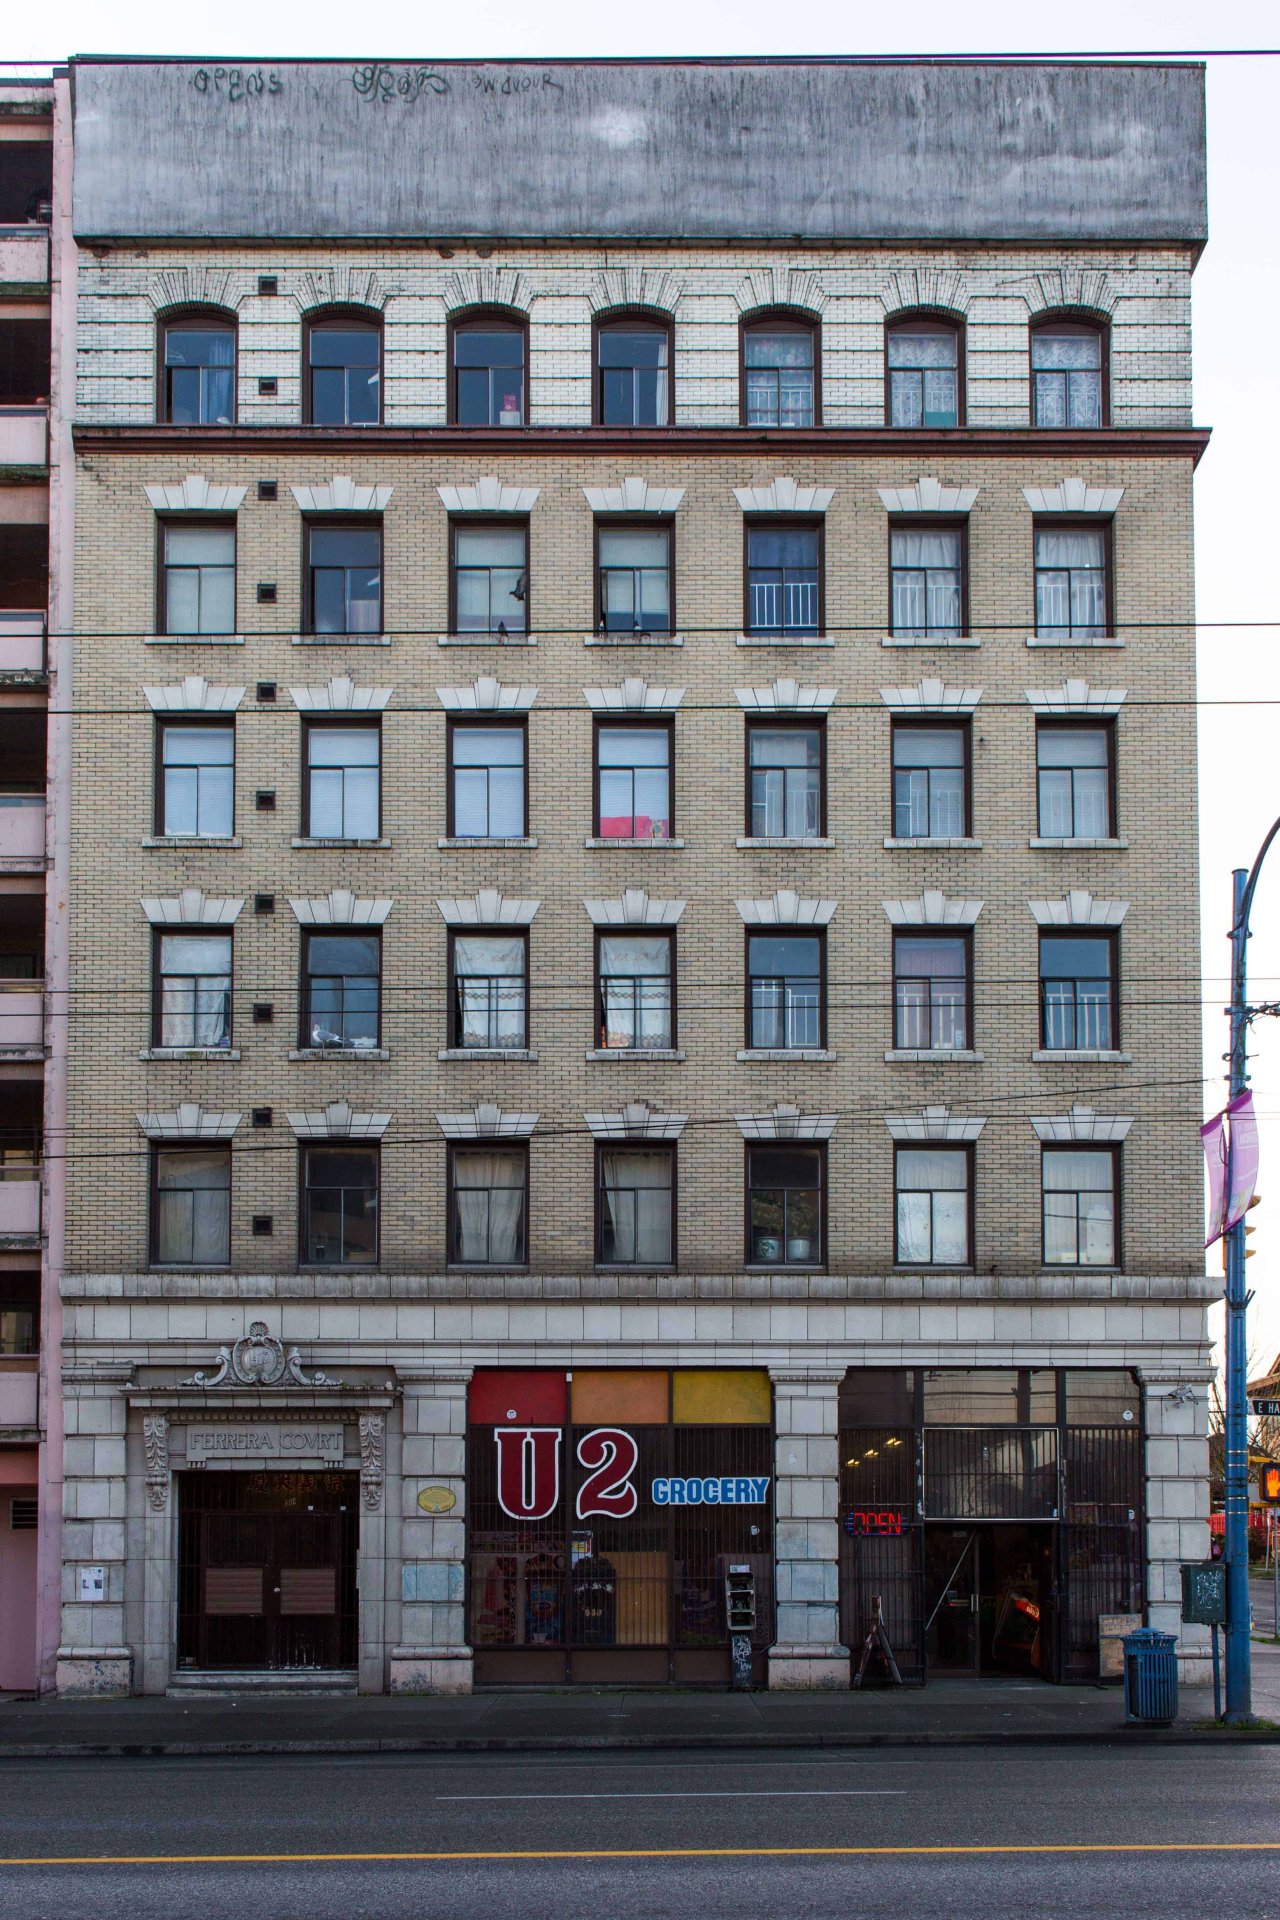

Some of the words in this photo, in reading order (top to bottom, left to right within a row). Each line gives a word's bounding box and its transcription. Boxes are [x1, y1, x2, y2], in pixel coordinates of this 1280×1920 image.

[249, 1352, 270, 1367] 1912
[1258, 1402, 1264, 1413] E
[190, 1432, 274, 1450] FERRERA
[280, 1431, 343, 1449] COVRT
[651, 1476, 770, 1505] GROCERY
[853, 1512, 902, 1535] OPEN
